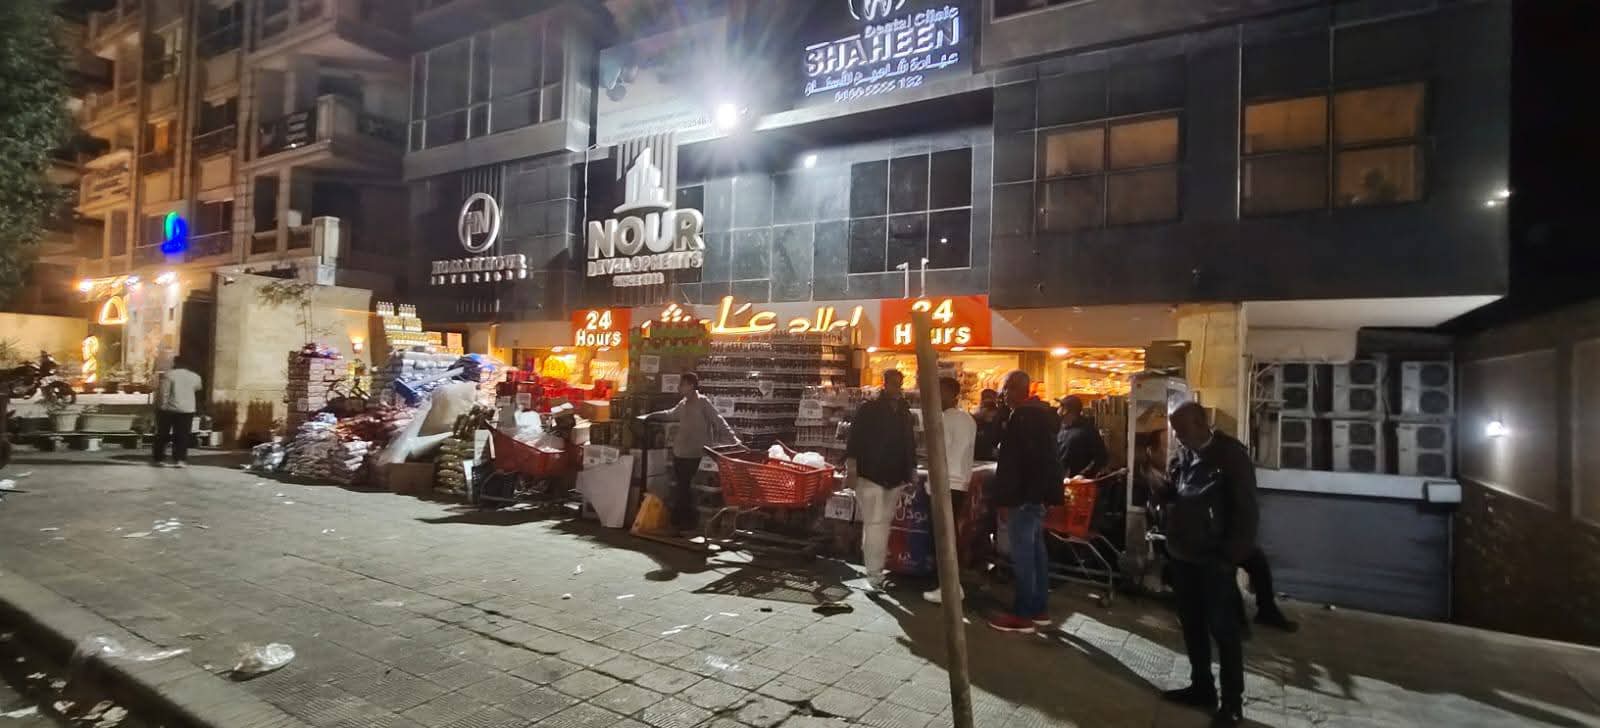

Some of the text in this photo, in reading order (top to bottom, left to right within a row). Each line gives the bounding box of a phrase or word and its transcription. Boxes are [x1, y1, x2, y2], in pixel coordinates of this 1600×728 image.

[805, 15, 960, 78] SHAHEEN
[587, 207, 706, 260] NOUR
[585, 309, 613, 331] 24
[575, 328, 622, 348] Hours
[893, 322, 972, 346] Hurs
